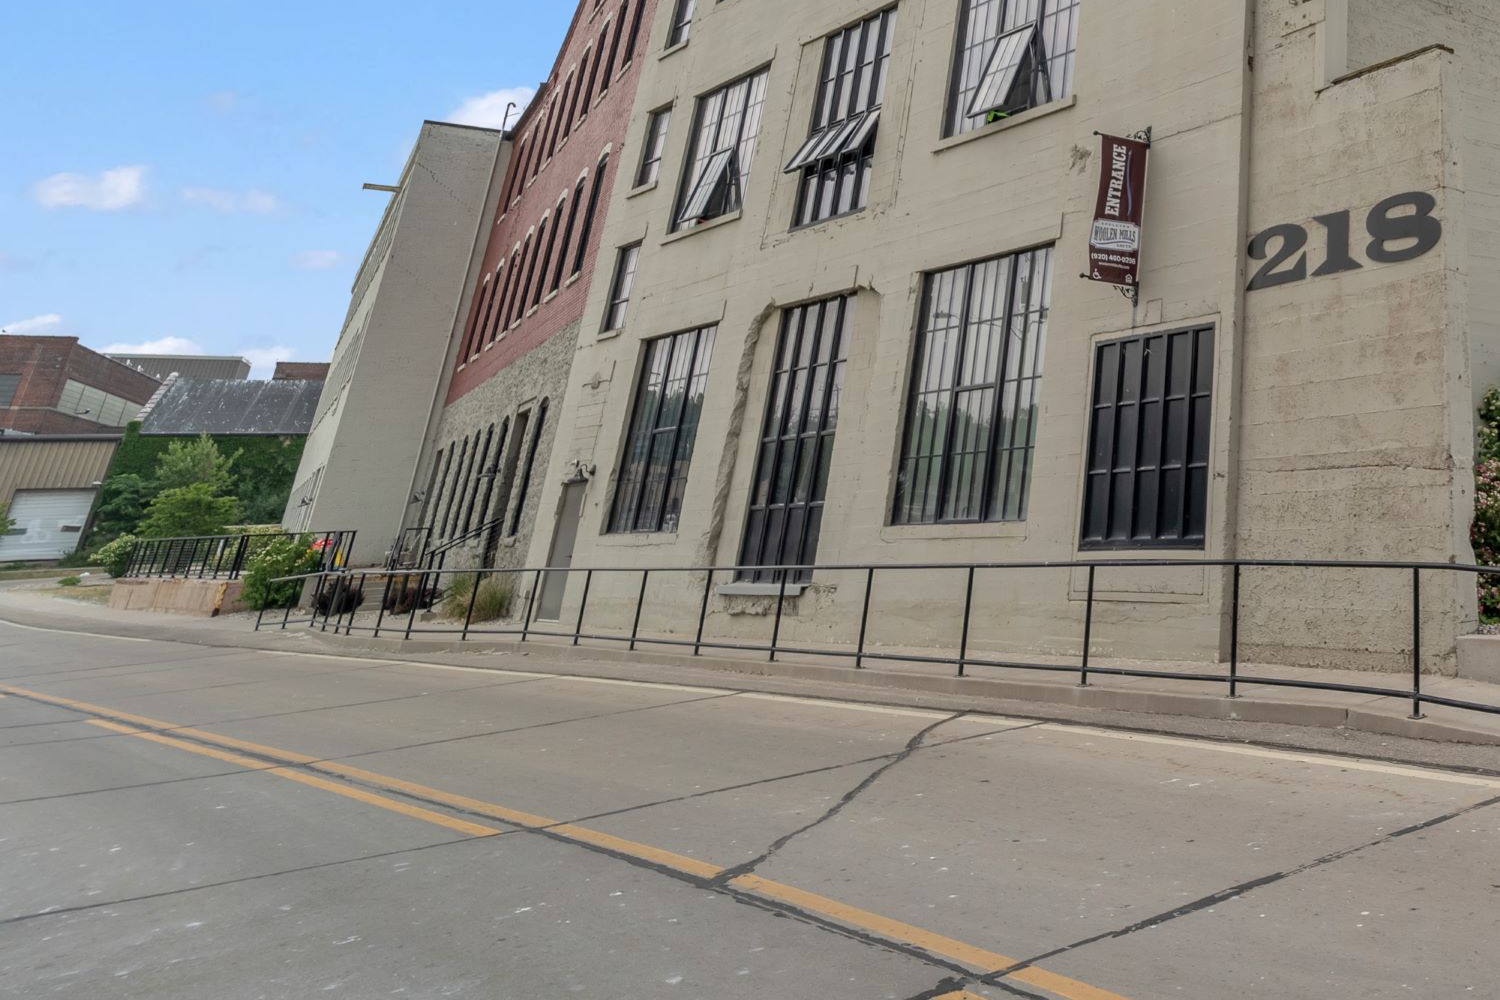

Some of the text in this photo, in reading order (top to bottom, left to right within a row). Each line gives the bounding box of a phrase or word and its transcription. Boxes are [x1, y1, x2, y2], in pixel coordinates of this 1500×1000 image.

[1104, 144, 1127, 217] ENTRANCE
[1093, 225, 1118, 242] WOOLEN
[1119, 229, 1136, 243] MILLS
[1246, 191, 1442, 292] 218
[1091, 252, 1108, 262] (920)
